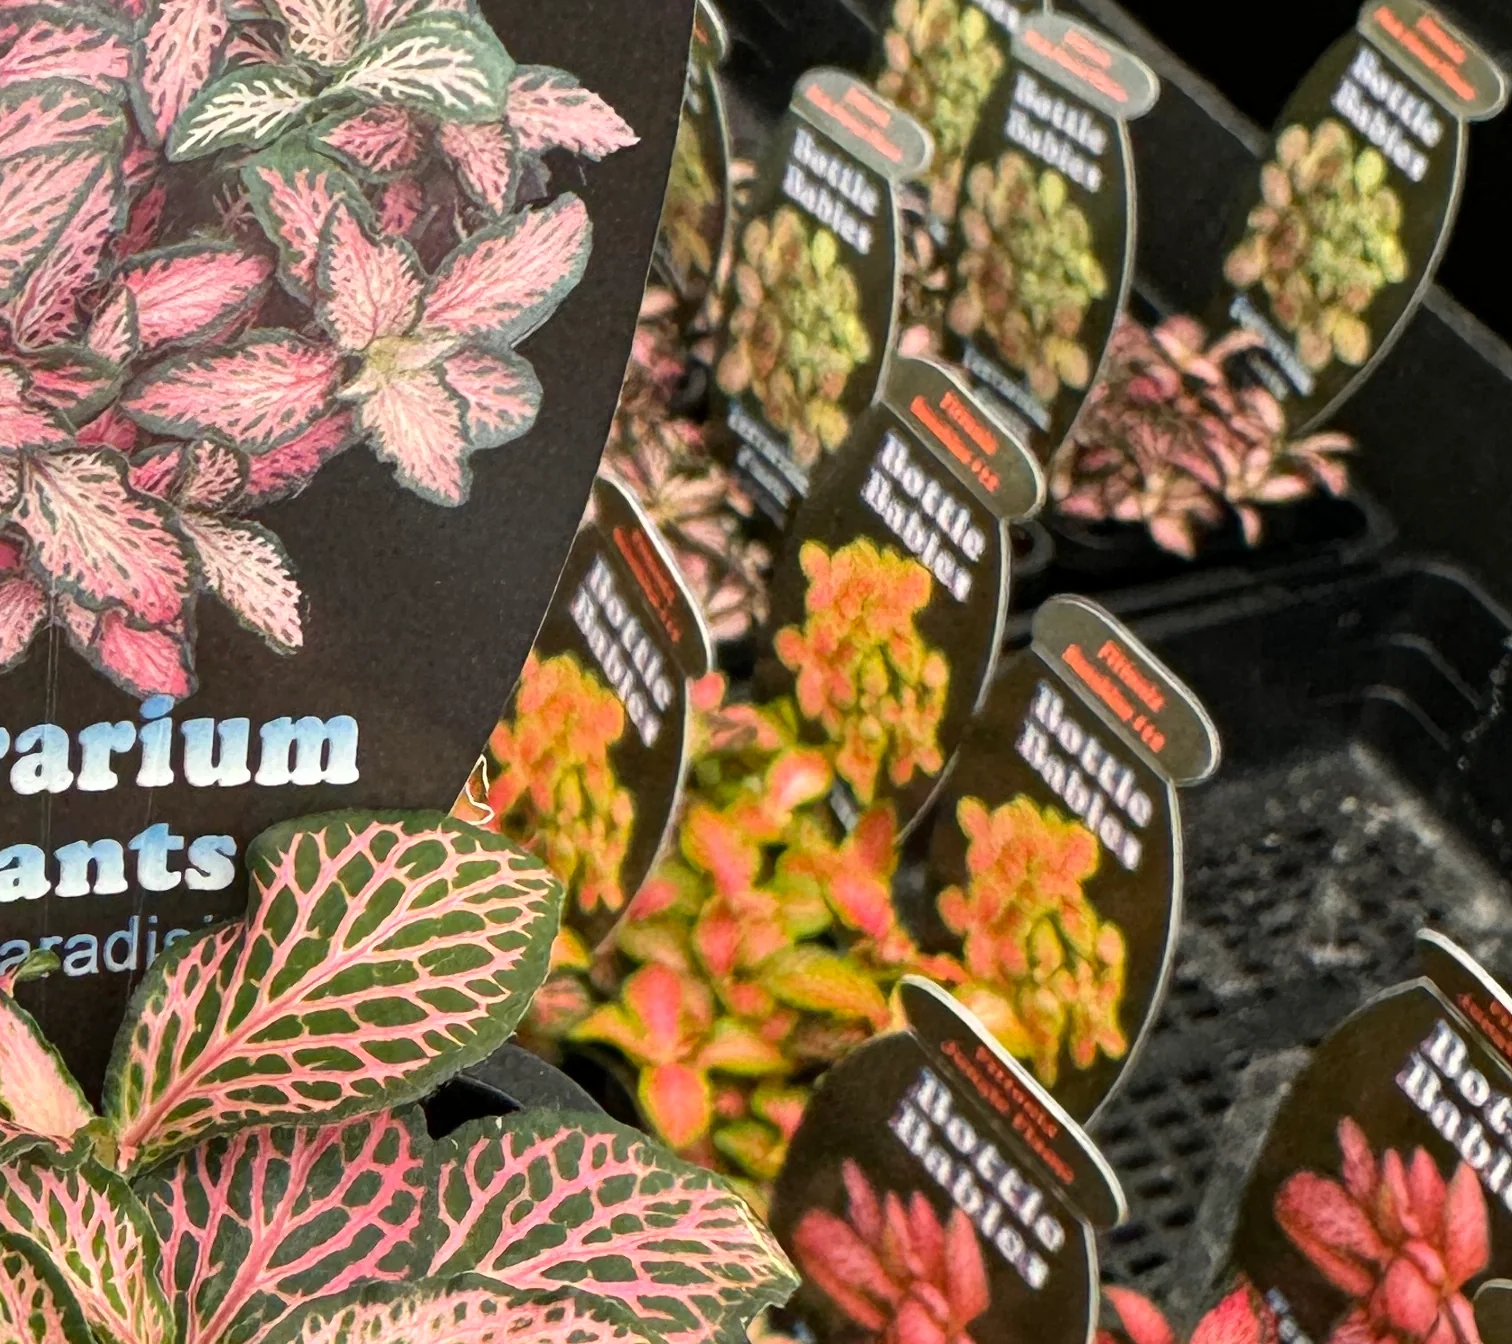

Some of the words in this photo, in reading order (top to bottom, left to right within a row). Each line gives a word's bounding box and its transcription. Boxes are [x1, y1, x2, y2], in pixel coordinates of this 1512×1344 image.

[1014, 71, 1107, 155] Bottle
[1350, 47, 1443, 148] Bottle
[861, 467, 972, 602] Babies
[879, 429, 986, 562] Bottle
[589, 553, 673, 712] Bottle
[1016, 719, 1142, 870] Babies
[1031, 679, 1153, 828] Bottle
[888, 1098, 1050, 1289] Babies
[904, 1065, 1065, 1253] Bottle
